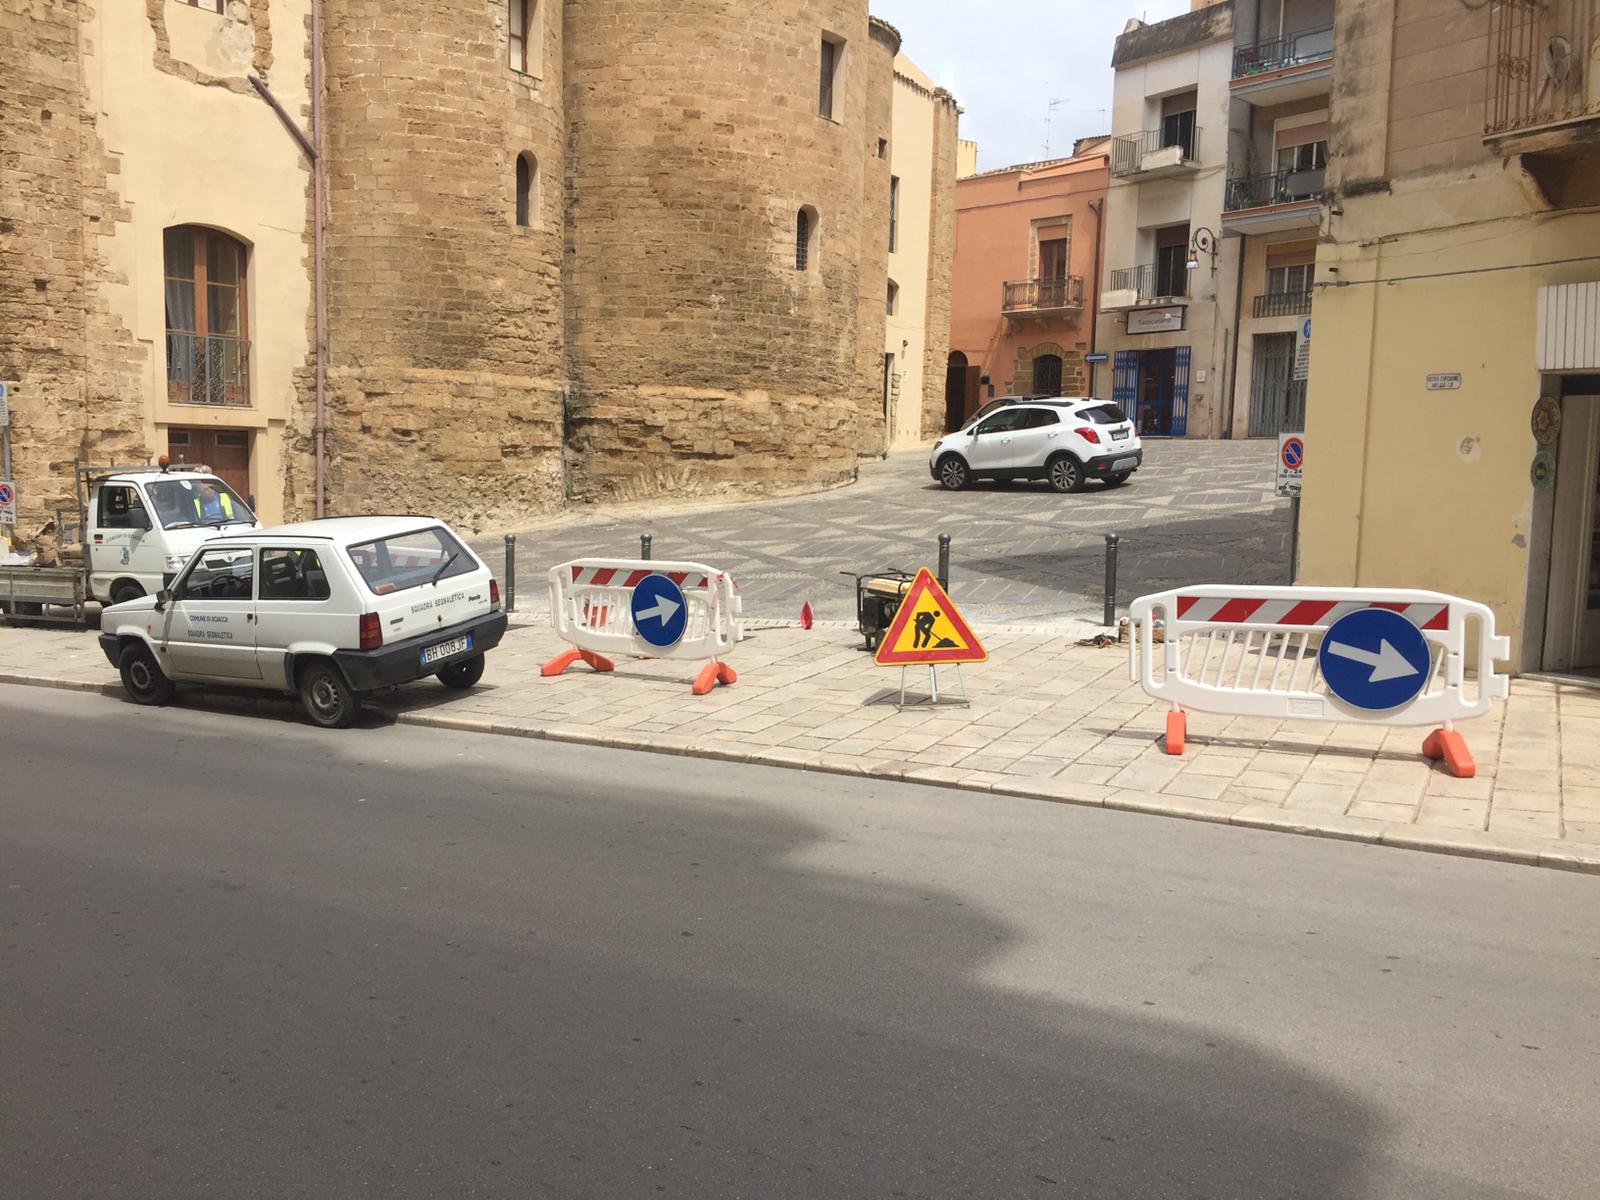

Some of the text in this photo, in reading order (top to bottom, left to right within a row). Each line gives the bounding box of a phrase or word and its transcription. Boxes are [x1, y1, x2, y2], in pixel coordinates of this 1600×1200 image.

[411, 592, 464, 614] SQUADRA SEGNALETICA
[211, 615, 228, 623] SCIACCA
[188, 630, 233, 639] SQUADRA SEGNALETICA
[426, 647, 438, 661] BH
